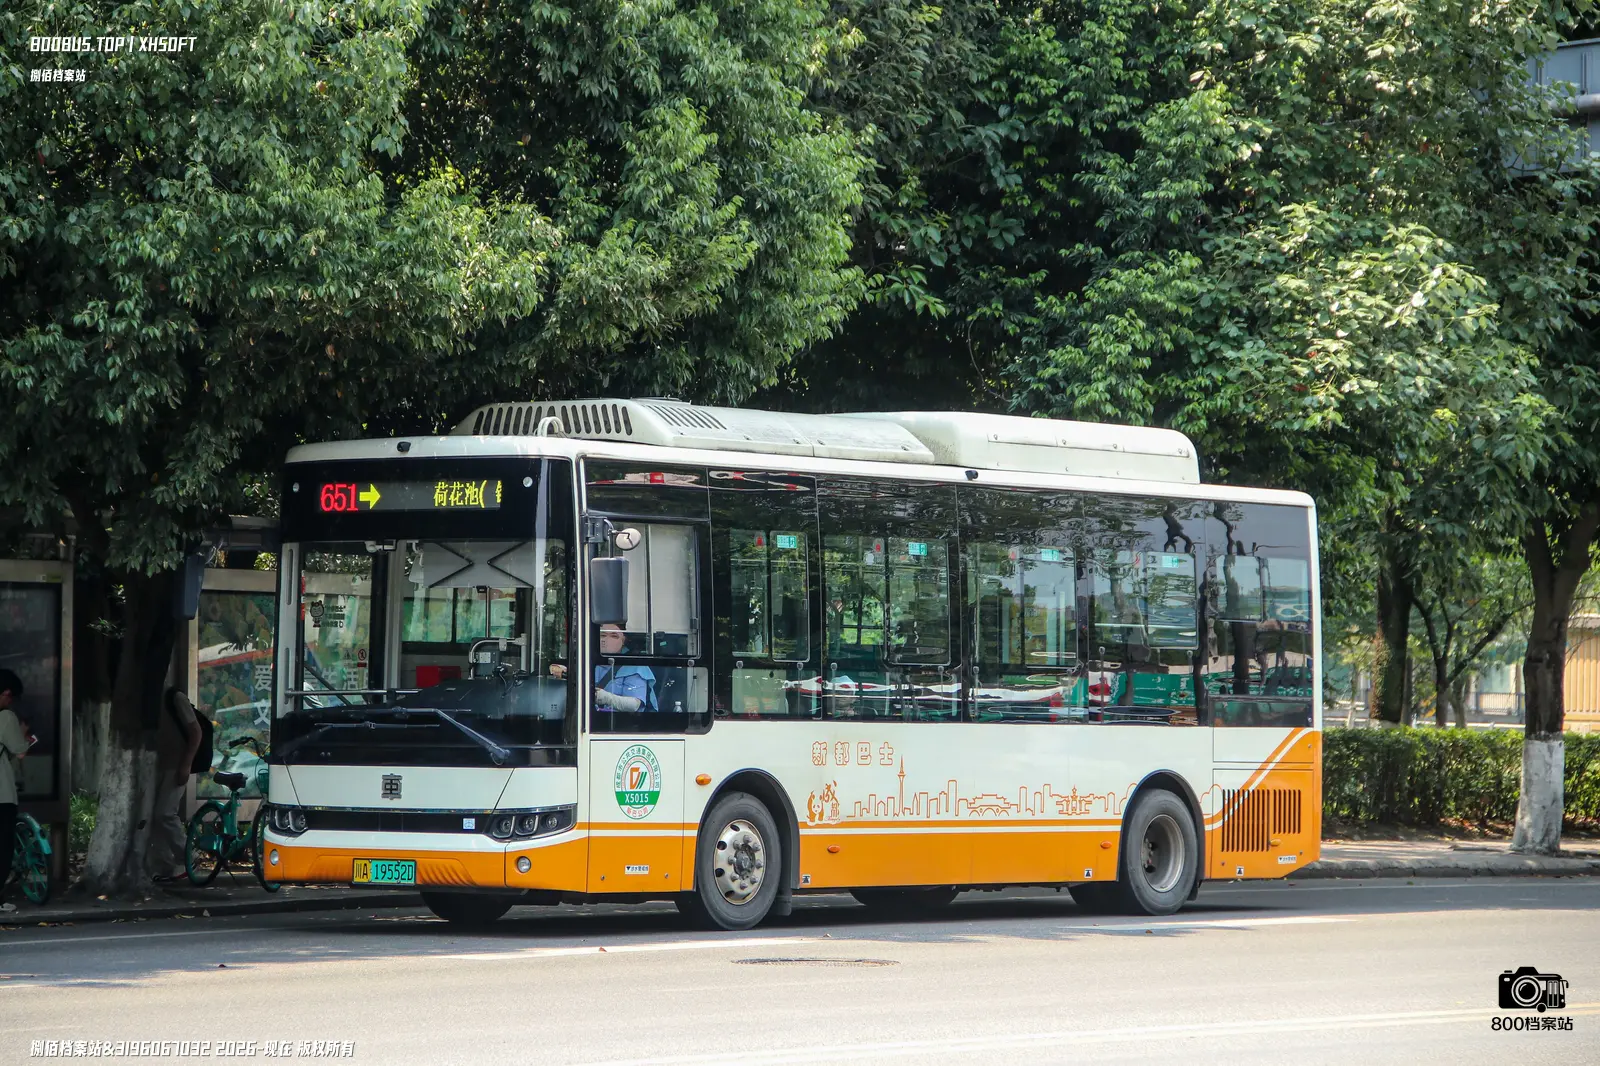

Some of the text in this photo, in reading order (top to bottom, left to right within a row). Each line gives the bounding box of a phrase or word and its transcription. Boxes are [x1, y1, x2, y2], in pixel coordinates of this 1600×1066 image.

[320, 483, 359, 512] 651
[811, 740, 895, 767] 新都巴士
[624, 792, 650, 804] X5015
